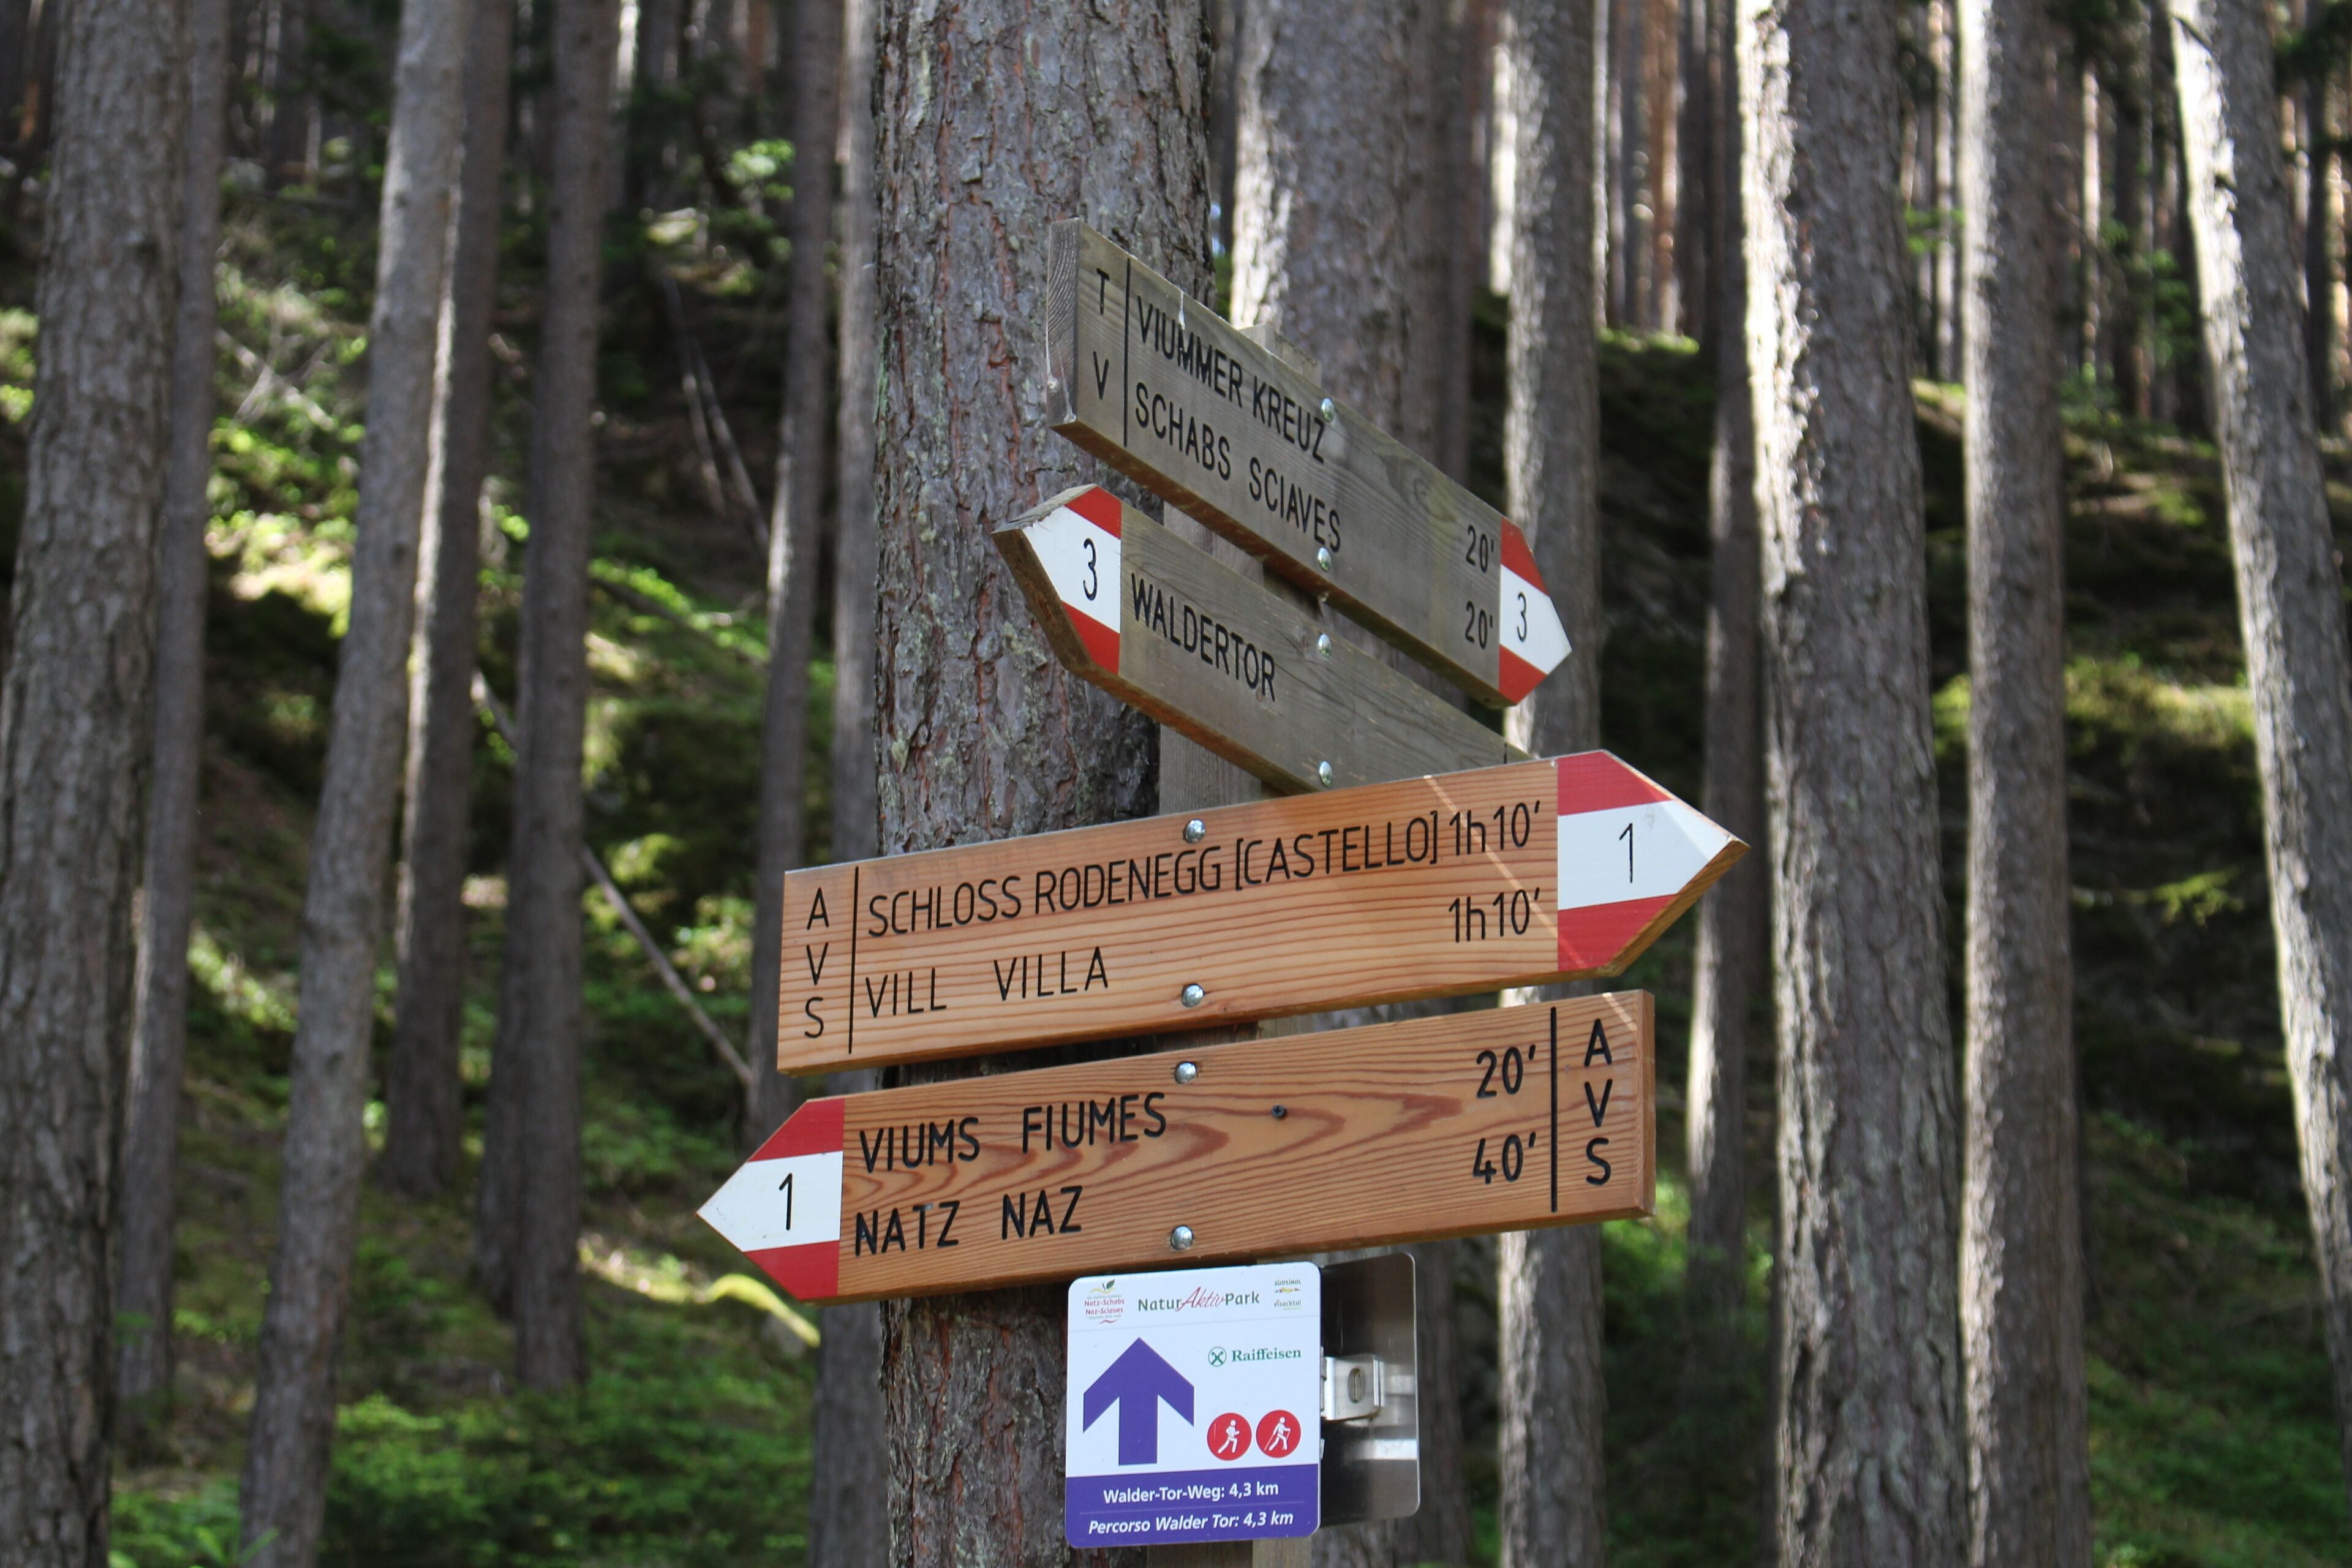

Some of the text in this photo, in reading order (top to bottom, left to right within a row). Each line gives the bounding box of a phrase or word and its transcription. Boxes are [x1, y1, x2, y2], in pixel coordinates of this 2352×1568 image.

[1137, 295, 1325, 464] VIUMMER KREUZ
[1135, 382, 1341, 553] SCHABS SCIAVES
[1082, 537, 1098, 601] 3
[1466, 524, 1494, 573] 20'
[1131, 571, 1276, 703] WALDERTOR
[1464, 600, 1493, 650] 20'
[1516, 592, 1528, 643] 3
[1619, 822, 1634, 884] 1
[868, 875, 1022, 938] SCHLOSS
[1035, 845, 1221, 915] RODENEGG
[865, 967, 948, 1019] VILL
[993, 946, 1109, 1001] VILLA
[859, 1044, 1536, 1174] VIUMS FIUMES 20'
[778, 1172, 793, 1231] 1
[854, 1131, 1537, 1257] NATZ NAZ 40'
[1084, 1298, 1125, 1307] Natz-Schabs
[1085, 1307, 1124, 1316] Naz-Sciaves
[1231, 1347, 1302, 1362] Raiffeisen
[1088, 1510, 1294, 1534] Percorso Walder Tor: 4,3 km
[1103, 1481, 1280, 1504] Walder-Tor-Weg: 4,3 km
